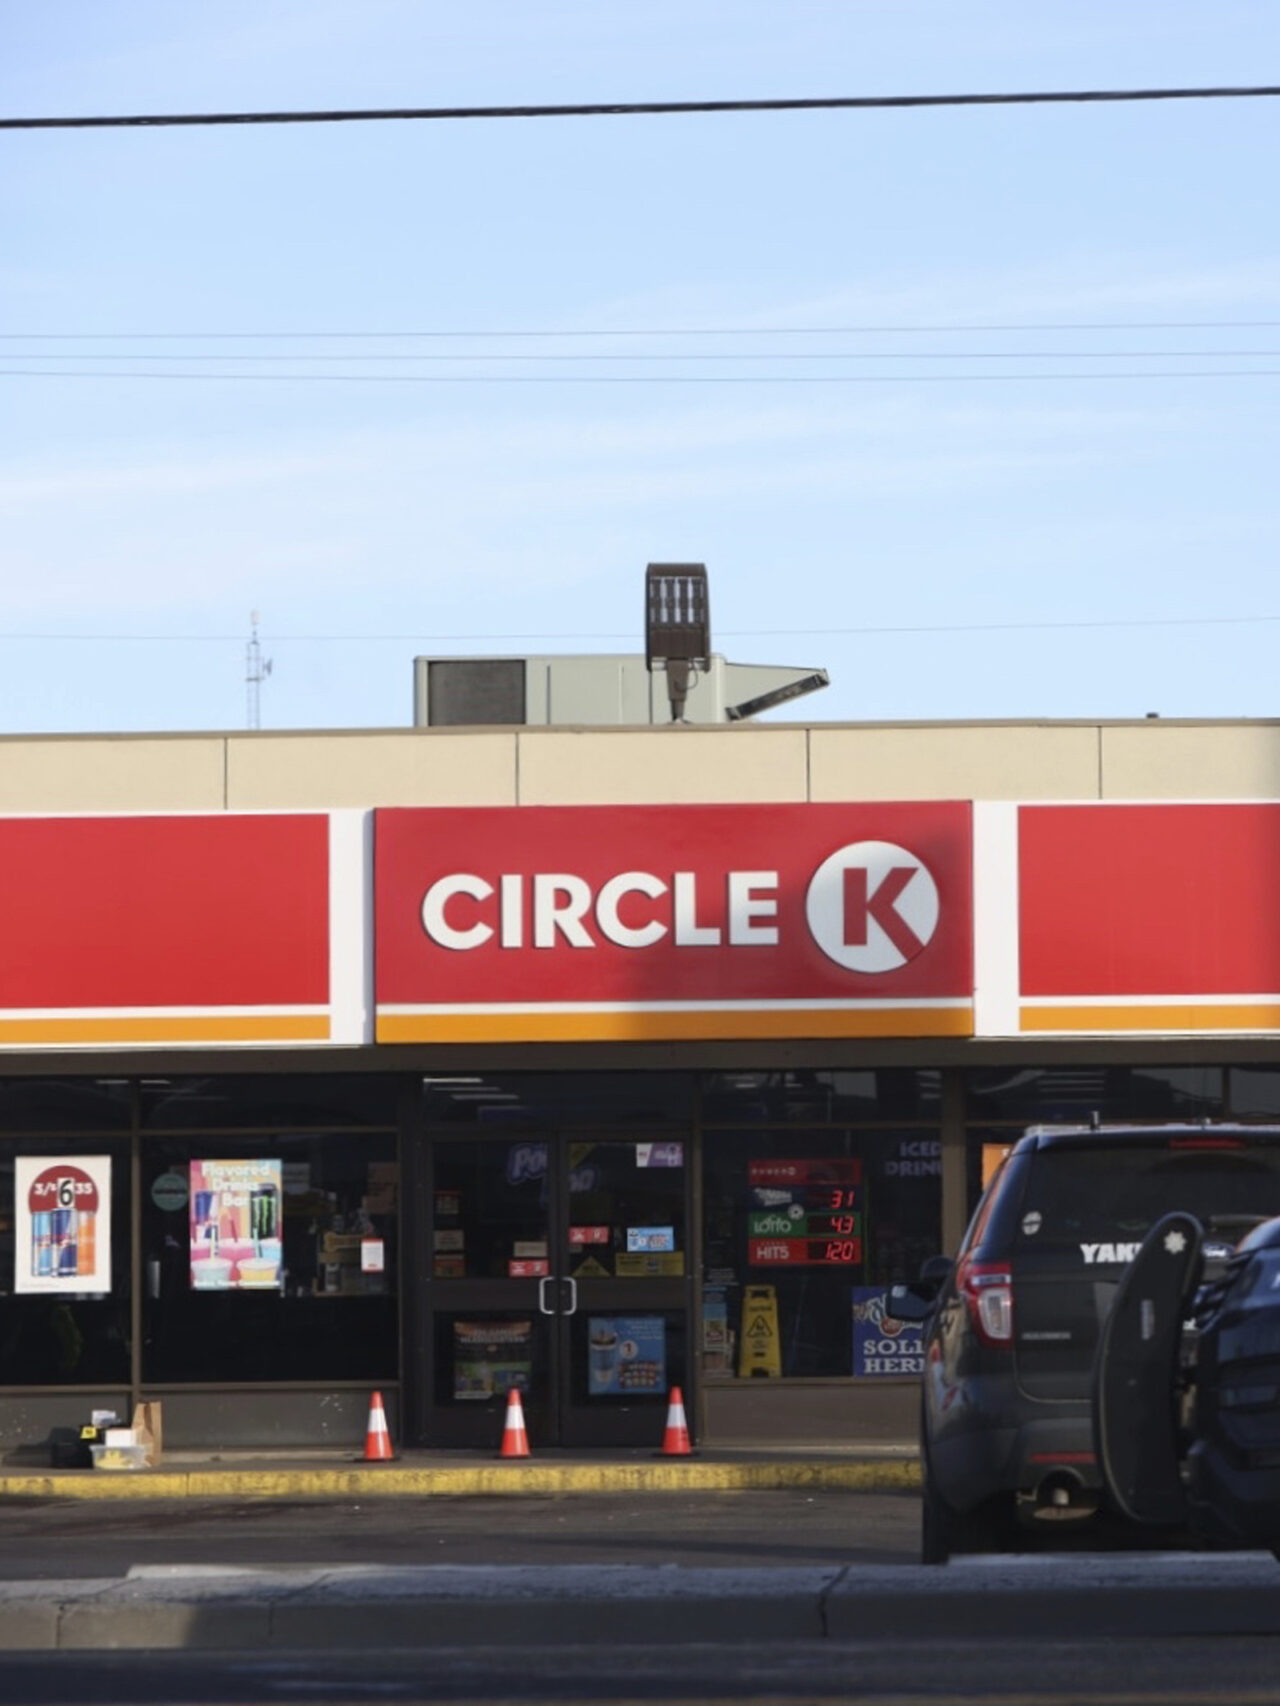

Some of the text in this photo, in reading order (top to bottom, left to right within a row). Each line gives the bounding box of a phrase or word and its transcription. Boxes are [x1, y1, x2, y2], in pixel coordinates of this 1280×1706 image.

[421, 871, 779, 950] CIRCLE
[201, 1162, 270, 1177] Flavored
[830, 1189, 856, 1209] 31
[829, 1214, 855, 1235] 43
[824, 1240, 855, 1261] 120
